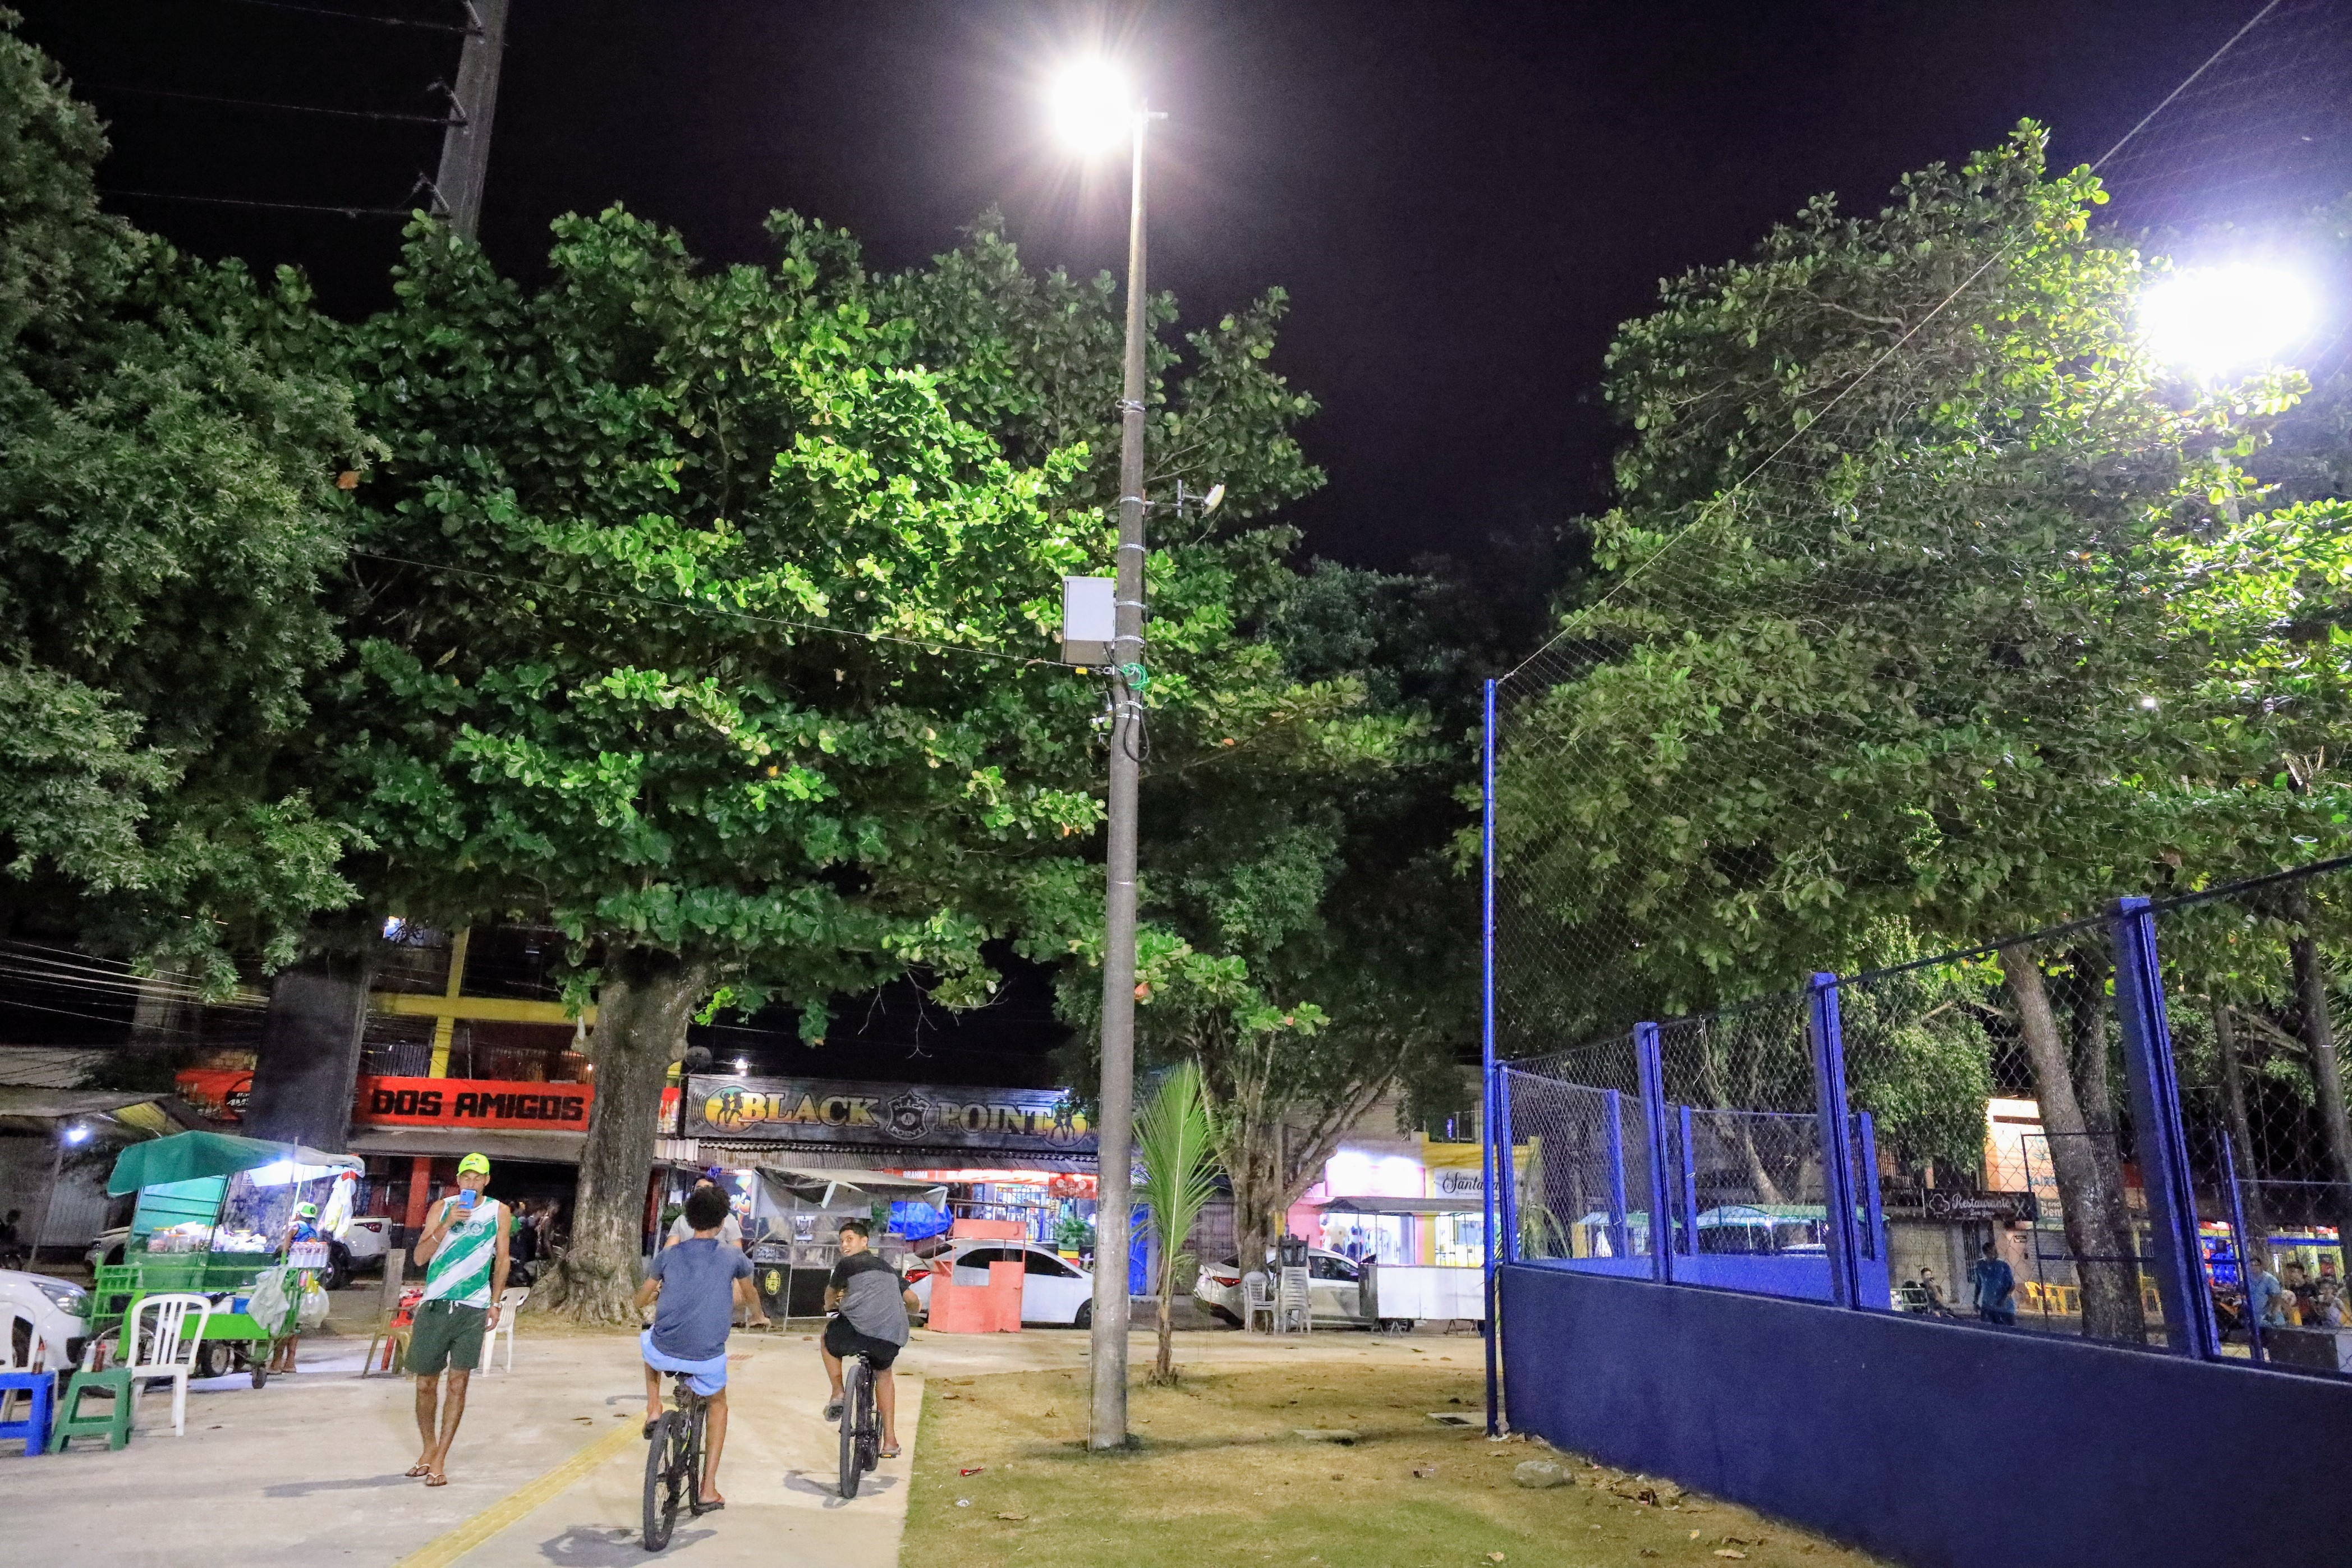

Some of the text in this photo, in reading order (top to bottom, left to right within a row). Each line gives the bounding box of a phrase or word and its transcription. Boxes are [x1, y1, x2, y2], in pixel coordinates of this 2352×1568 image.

[371, 1089, 585, 1121] DOS AMIGOS
[738, 1092, 1053, 1136] BLACK POINT
[903, 1170, 928, 1179] BRAHMA
[1952, 1193, 2013, 1209] Restaurante
